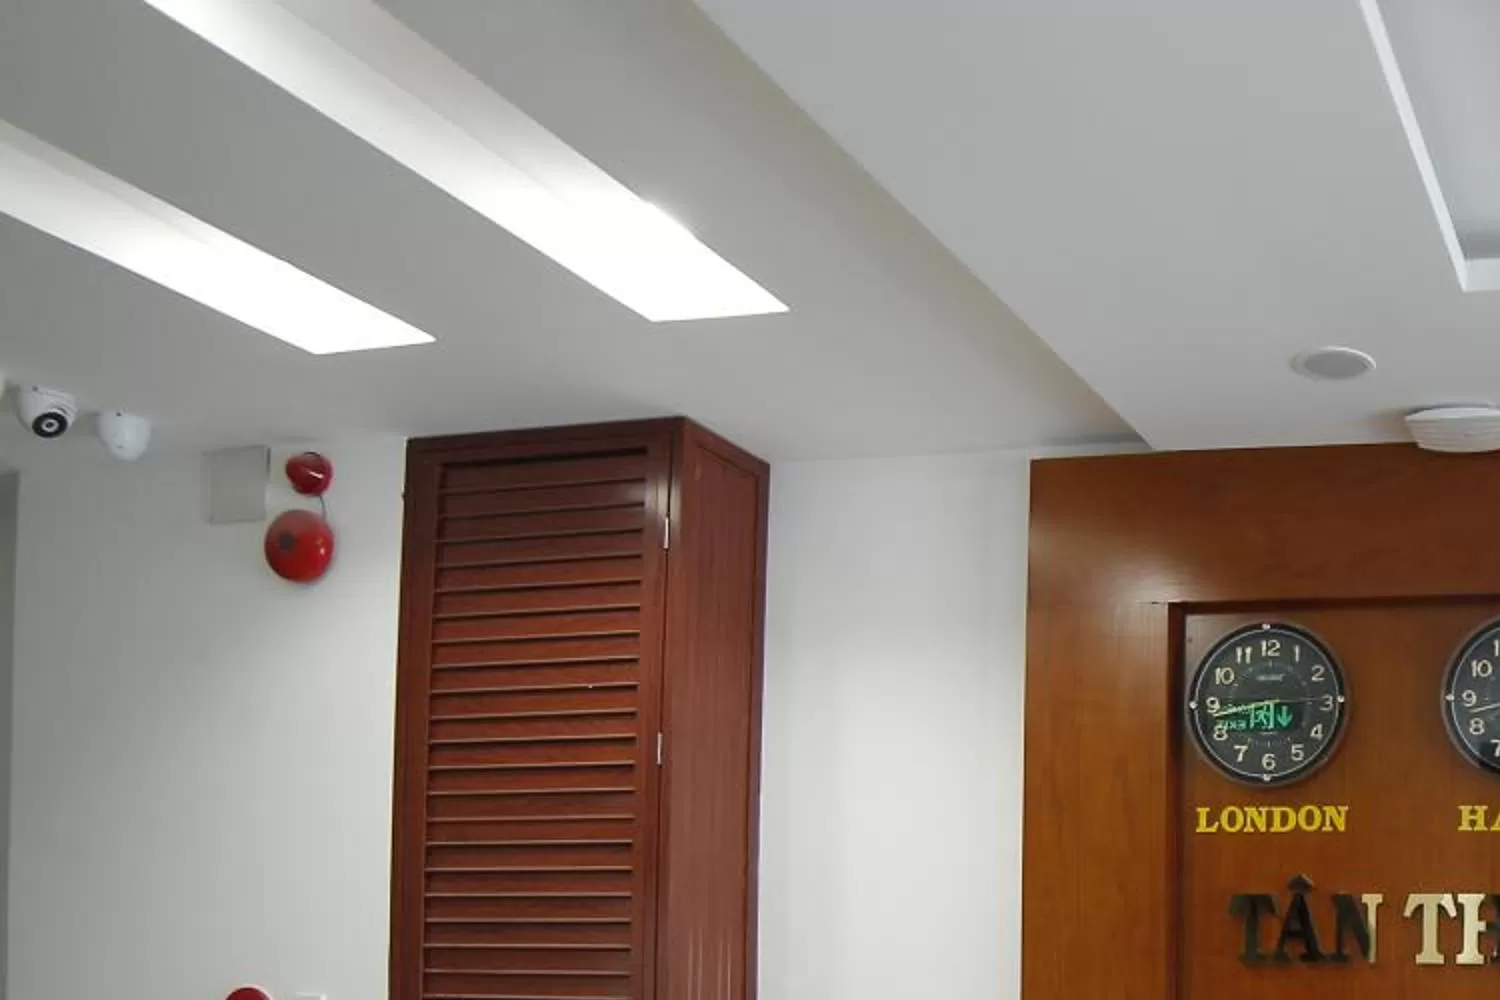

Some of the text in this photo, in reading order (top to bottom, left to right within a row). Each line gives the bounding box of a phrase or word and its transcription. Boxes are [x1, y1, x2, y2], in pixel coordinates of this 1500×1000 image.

[1235, 646, 1252, 664] 11
[1260, 639, 1281, 657] 12
[1294, 645, 1300, 662] 1
[1215, 667, 1235, 685] 10
[1311, 665, 1325, 682] 2
[1470, 659, 1493, 677] 10
[1205, 697, 1221, 714] 9
[1319, 695, 1333, 711] 3
[1461, 690, 1477, 707] 9
[1213, 724, 1229, 741] 8
[1310, 724, 1324, 740] 4
[1469, 717, 1485, 735] 8
[1233, 745, 1249, 762] 7
[1291, 744, 1305, 761] 5
[1261, 753, 1276, 771] 6
[1195, 805, 1349, 833] LONDON
[1228, 873, 1384, 966] TÂN
